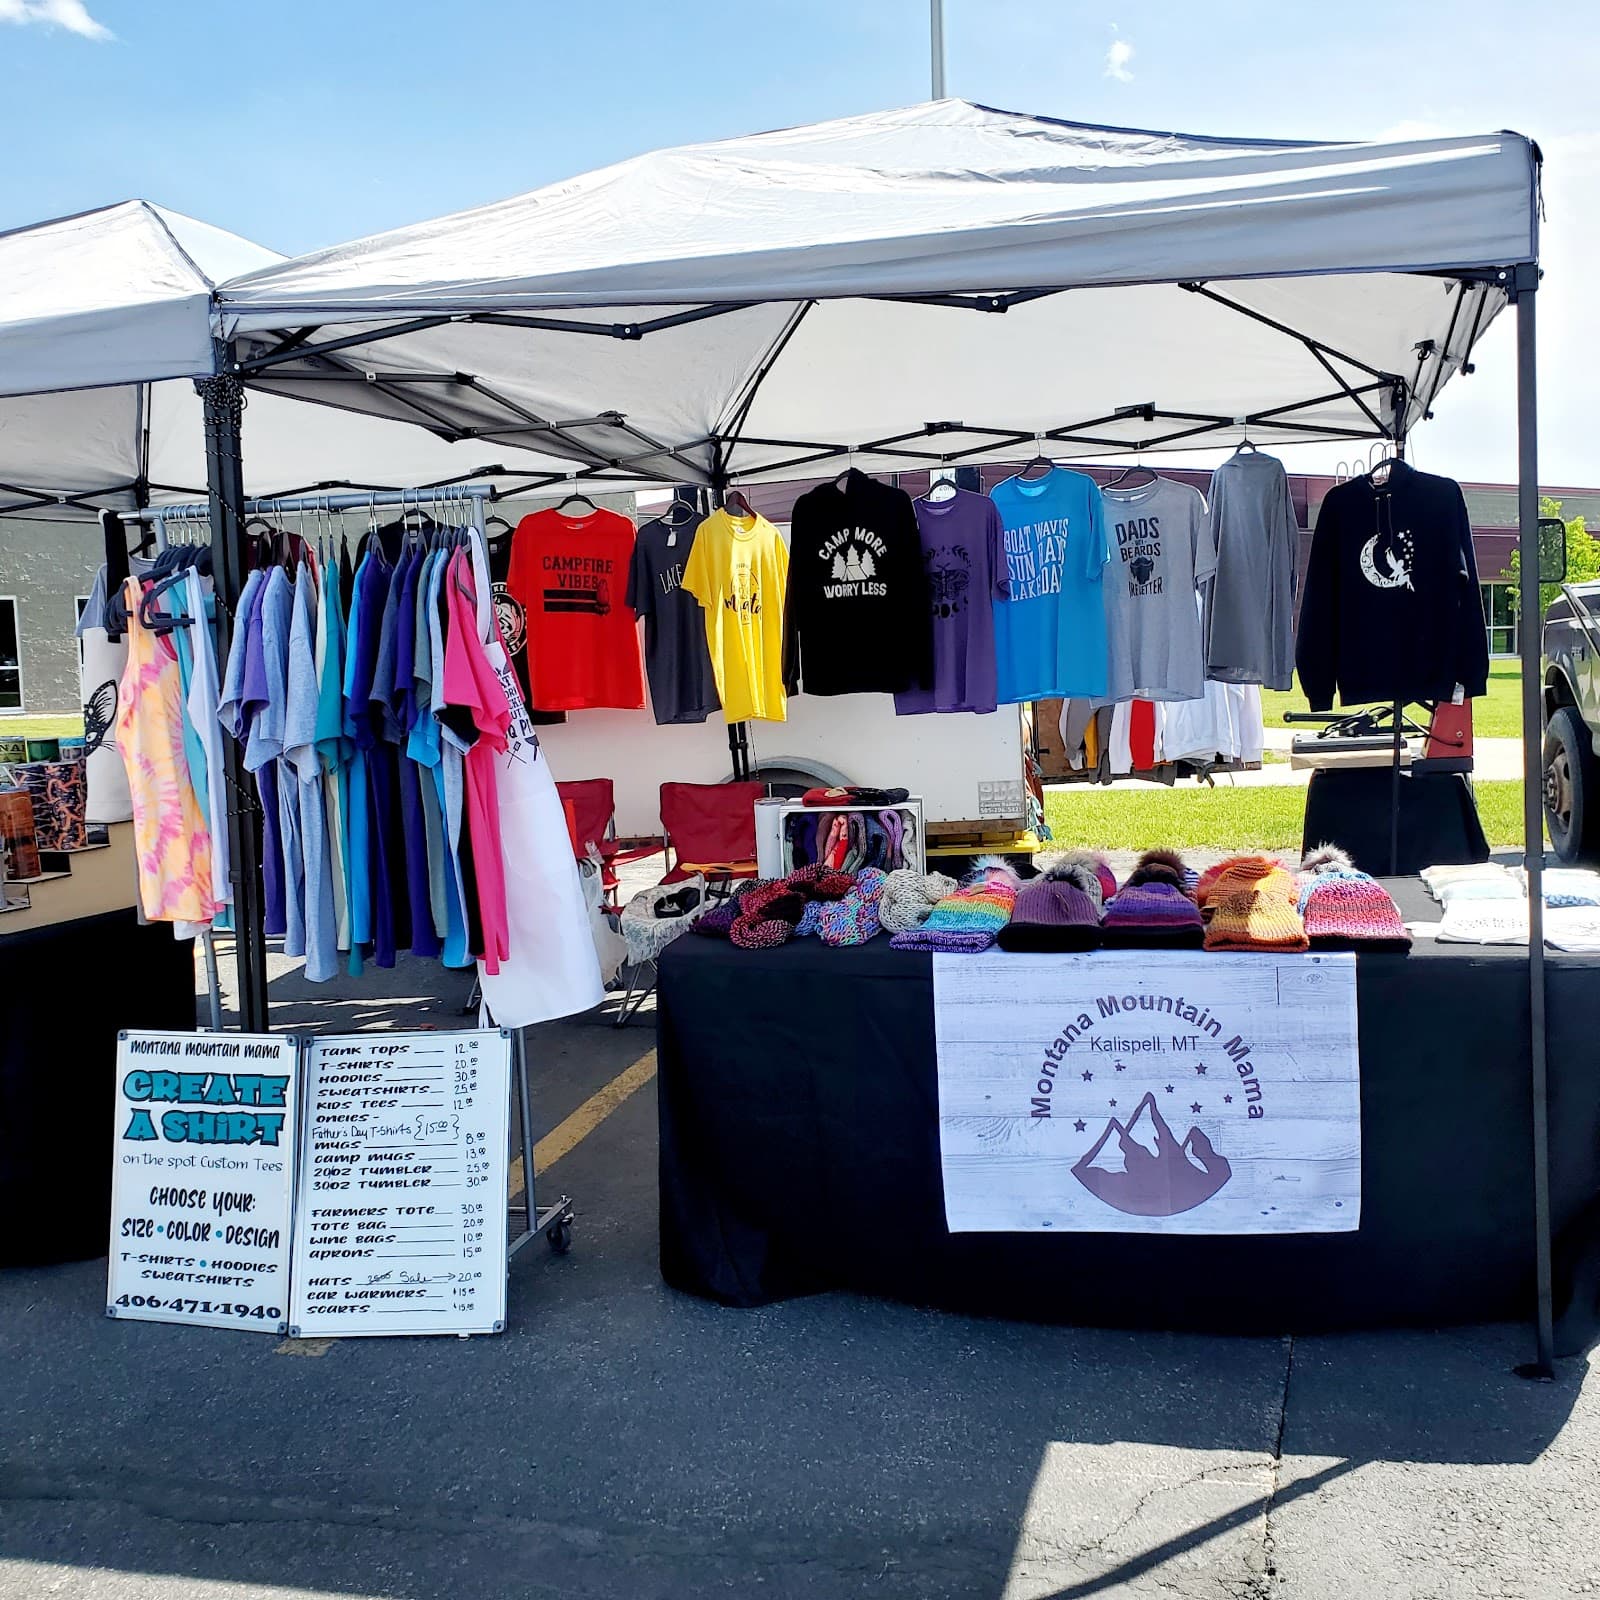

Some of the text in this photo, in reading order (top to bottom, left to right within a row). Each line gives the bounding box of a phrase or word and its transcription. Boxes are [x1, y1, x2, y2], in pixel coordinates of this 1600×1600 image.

[1004, 525, 1031, 554] BOAT
[1115, 517, 1160, 546] DADS
[818, 526, 888, 561] CAMP MORE
[1120, 542, 1161, 562] BEARDS
[543, 556, 614, 574] CAMPFIRE
[1006, 550, 1036, 582] SUN
[557, 573, 599, 590] VIBES
[823, 581, 887, 599] WORRY LESS
[1090, 1034, 1201, 1055] Kalispell, MT
[319, 1060, 394, 1071] T-SHIRTS
[1030, 994, 1265, 1120] Montana Mountain Mama
[123, 1069, 290, 1107] CREATE
[319, 1074, 383, 1083] HOODIES
[316, 1101, 352, 1110] KIDS
[122, 1108, 158, 1141] A
[351, 1125, 368, 1140] Day
[122, 1153, 283, 1174] on the spot Custom Tees
[166, 1220, 211, 1242] COLOR
[120, 1252, 278, 1274] T-SHIRTS HOODIES
